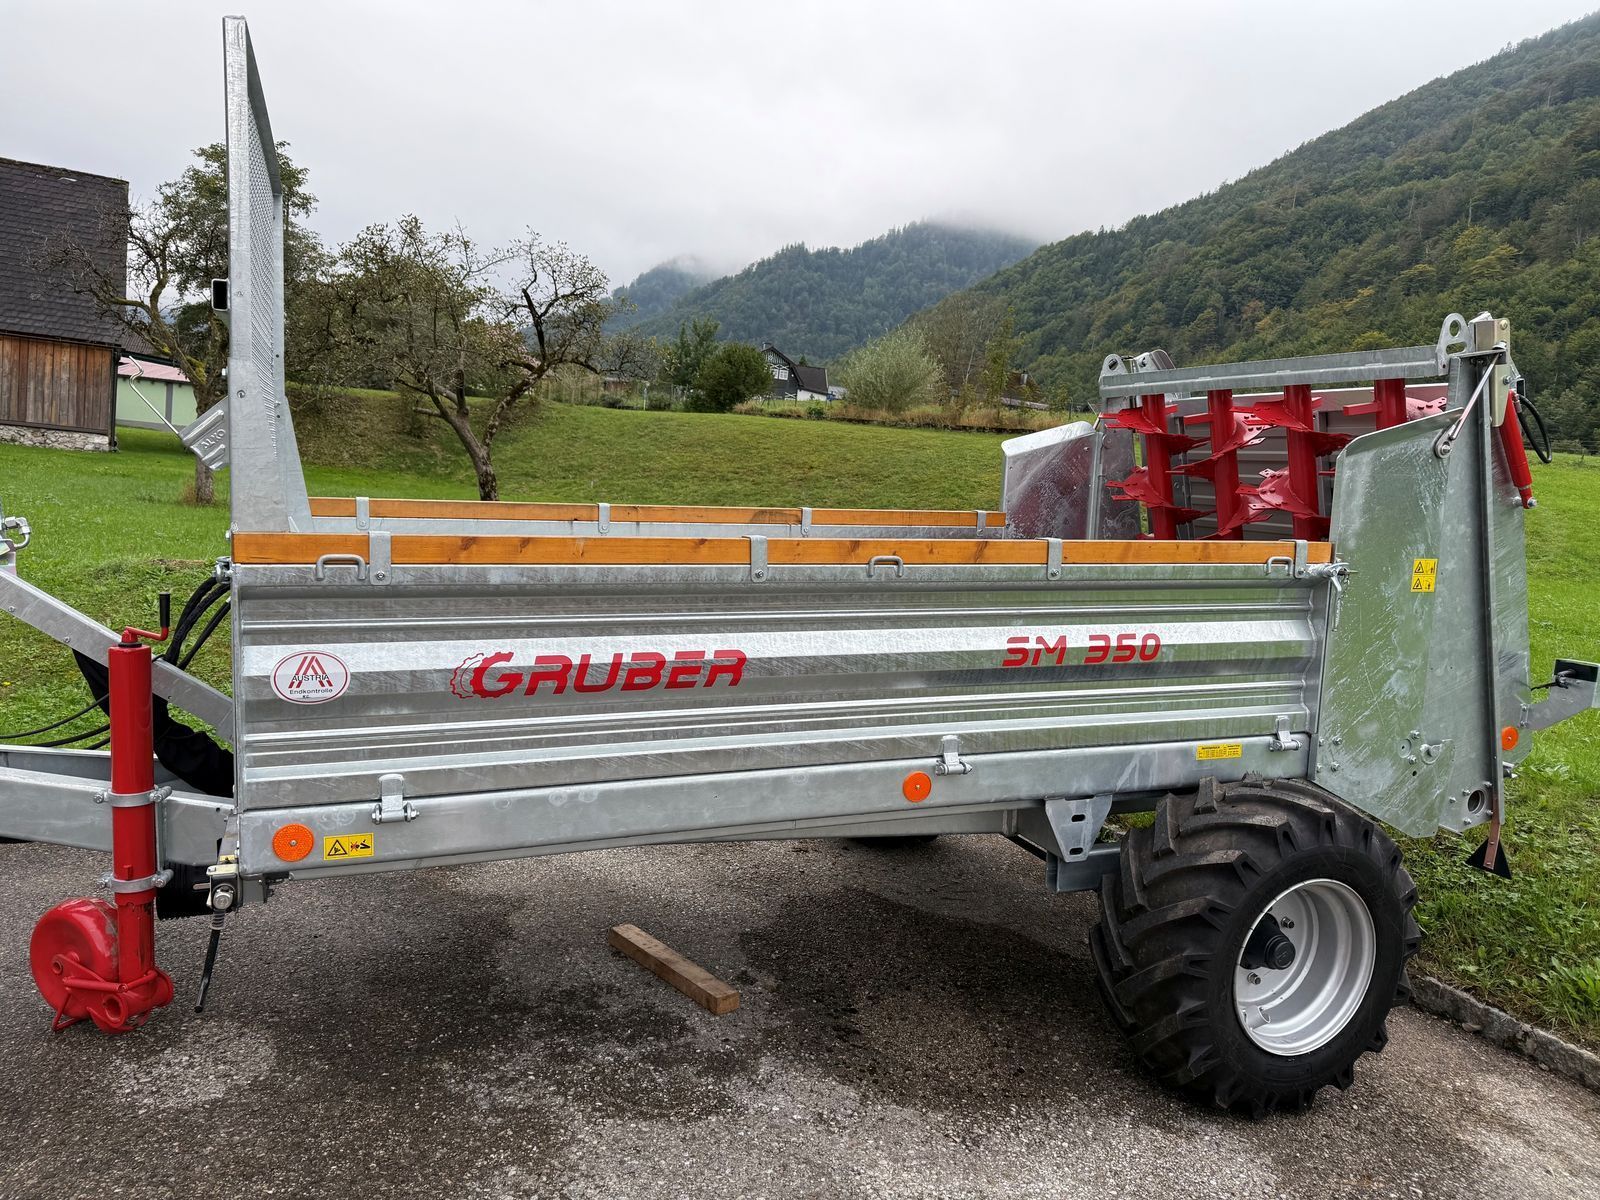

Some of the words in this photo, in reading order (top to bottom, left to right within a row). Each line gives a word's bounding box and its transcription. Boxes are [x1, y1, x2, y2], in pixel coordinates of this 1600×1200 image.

[1001, 635, 1067, 667] SM
[1083, 633, 1162, 664] 350
[292, 674, 330, 682] AUSTRIA
[470, 649, 747, 698] GRUBER
